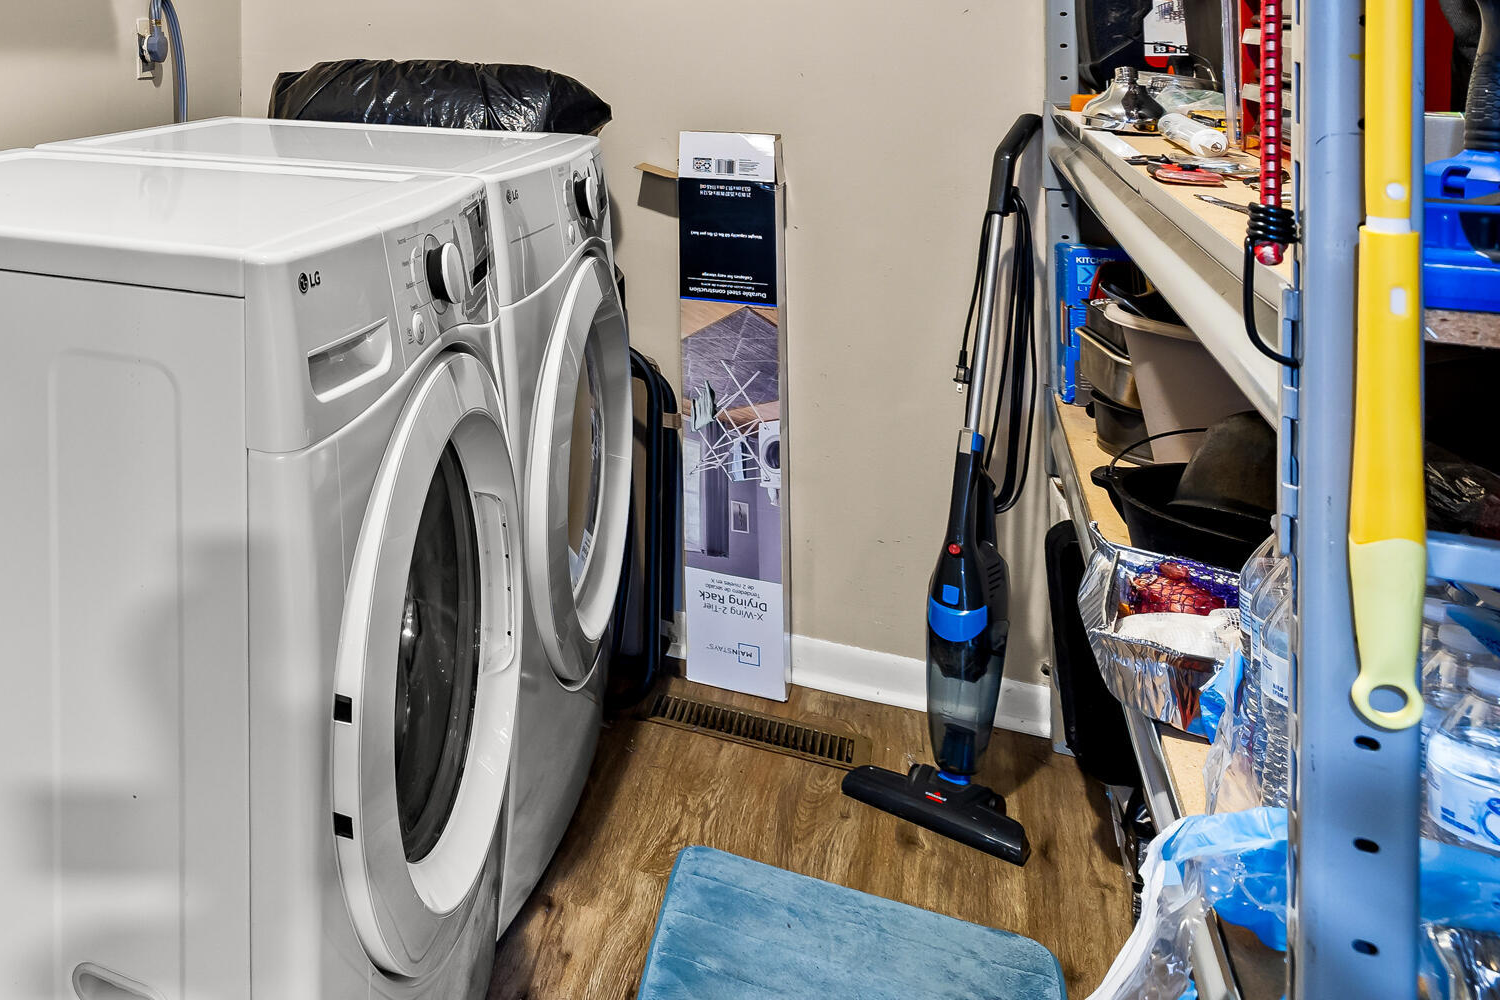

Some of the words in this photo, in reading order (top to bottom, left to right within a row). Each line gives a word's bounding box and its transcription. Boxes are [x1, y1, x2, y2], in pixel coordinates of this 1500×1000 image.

[511, 189, 519, 201] LG
[309, 271, 321, 288] LG
[689, 286, 726, 294] construction
[743, 290, 767, 298] Durable
[724, 580, 741, 588] niveles
[699, 590, 725, 604] Rack
[731, 588, 760, 598] Tendedero
[703, 602, 728, 614] 2-Tier
[729, 594, 767, 612] Drying
[731, 607, 764, 621] X-Wing
[709, 643, 753, 657] MAINSTAYS
